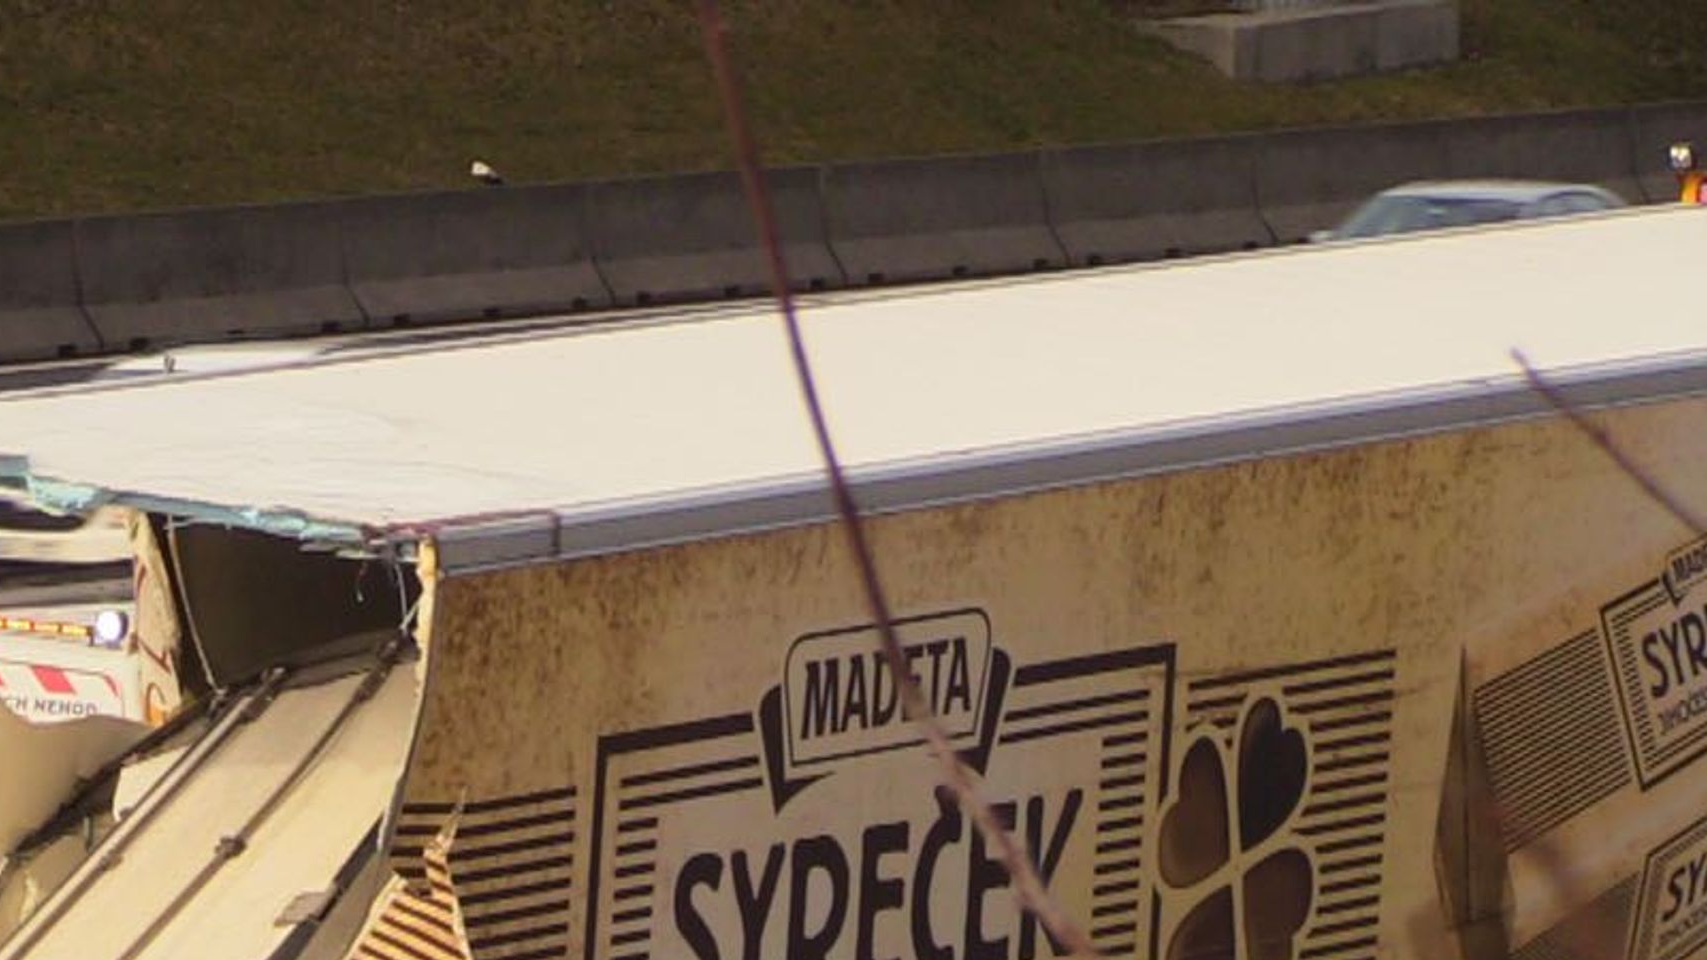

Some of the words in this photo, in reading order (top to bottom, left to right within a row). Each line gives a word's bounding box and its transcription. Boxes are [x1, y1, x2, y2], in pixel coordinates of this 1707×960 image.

[801, 637, 972, 740] MADETA
[1642, 603, 1707, 698] SYR
[33, 698, 98, 717] NEHOD
